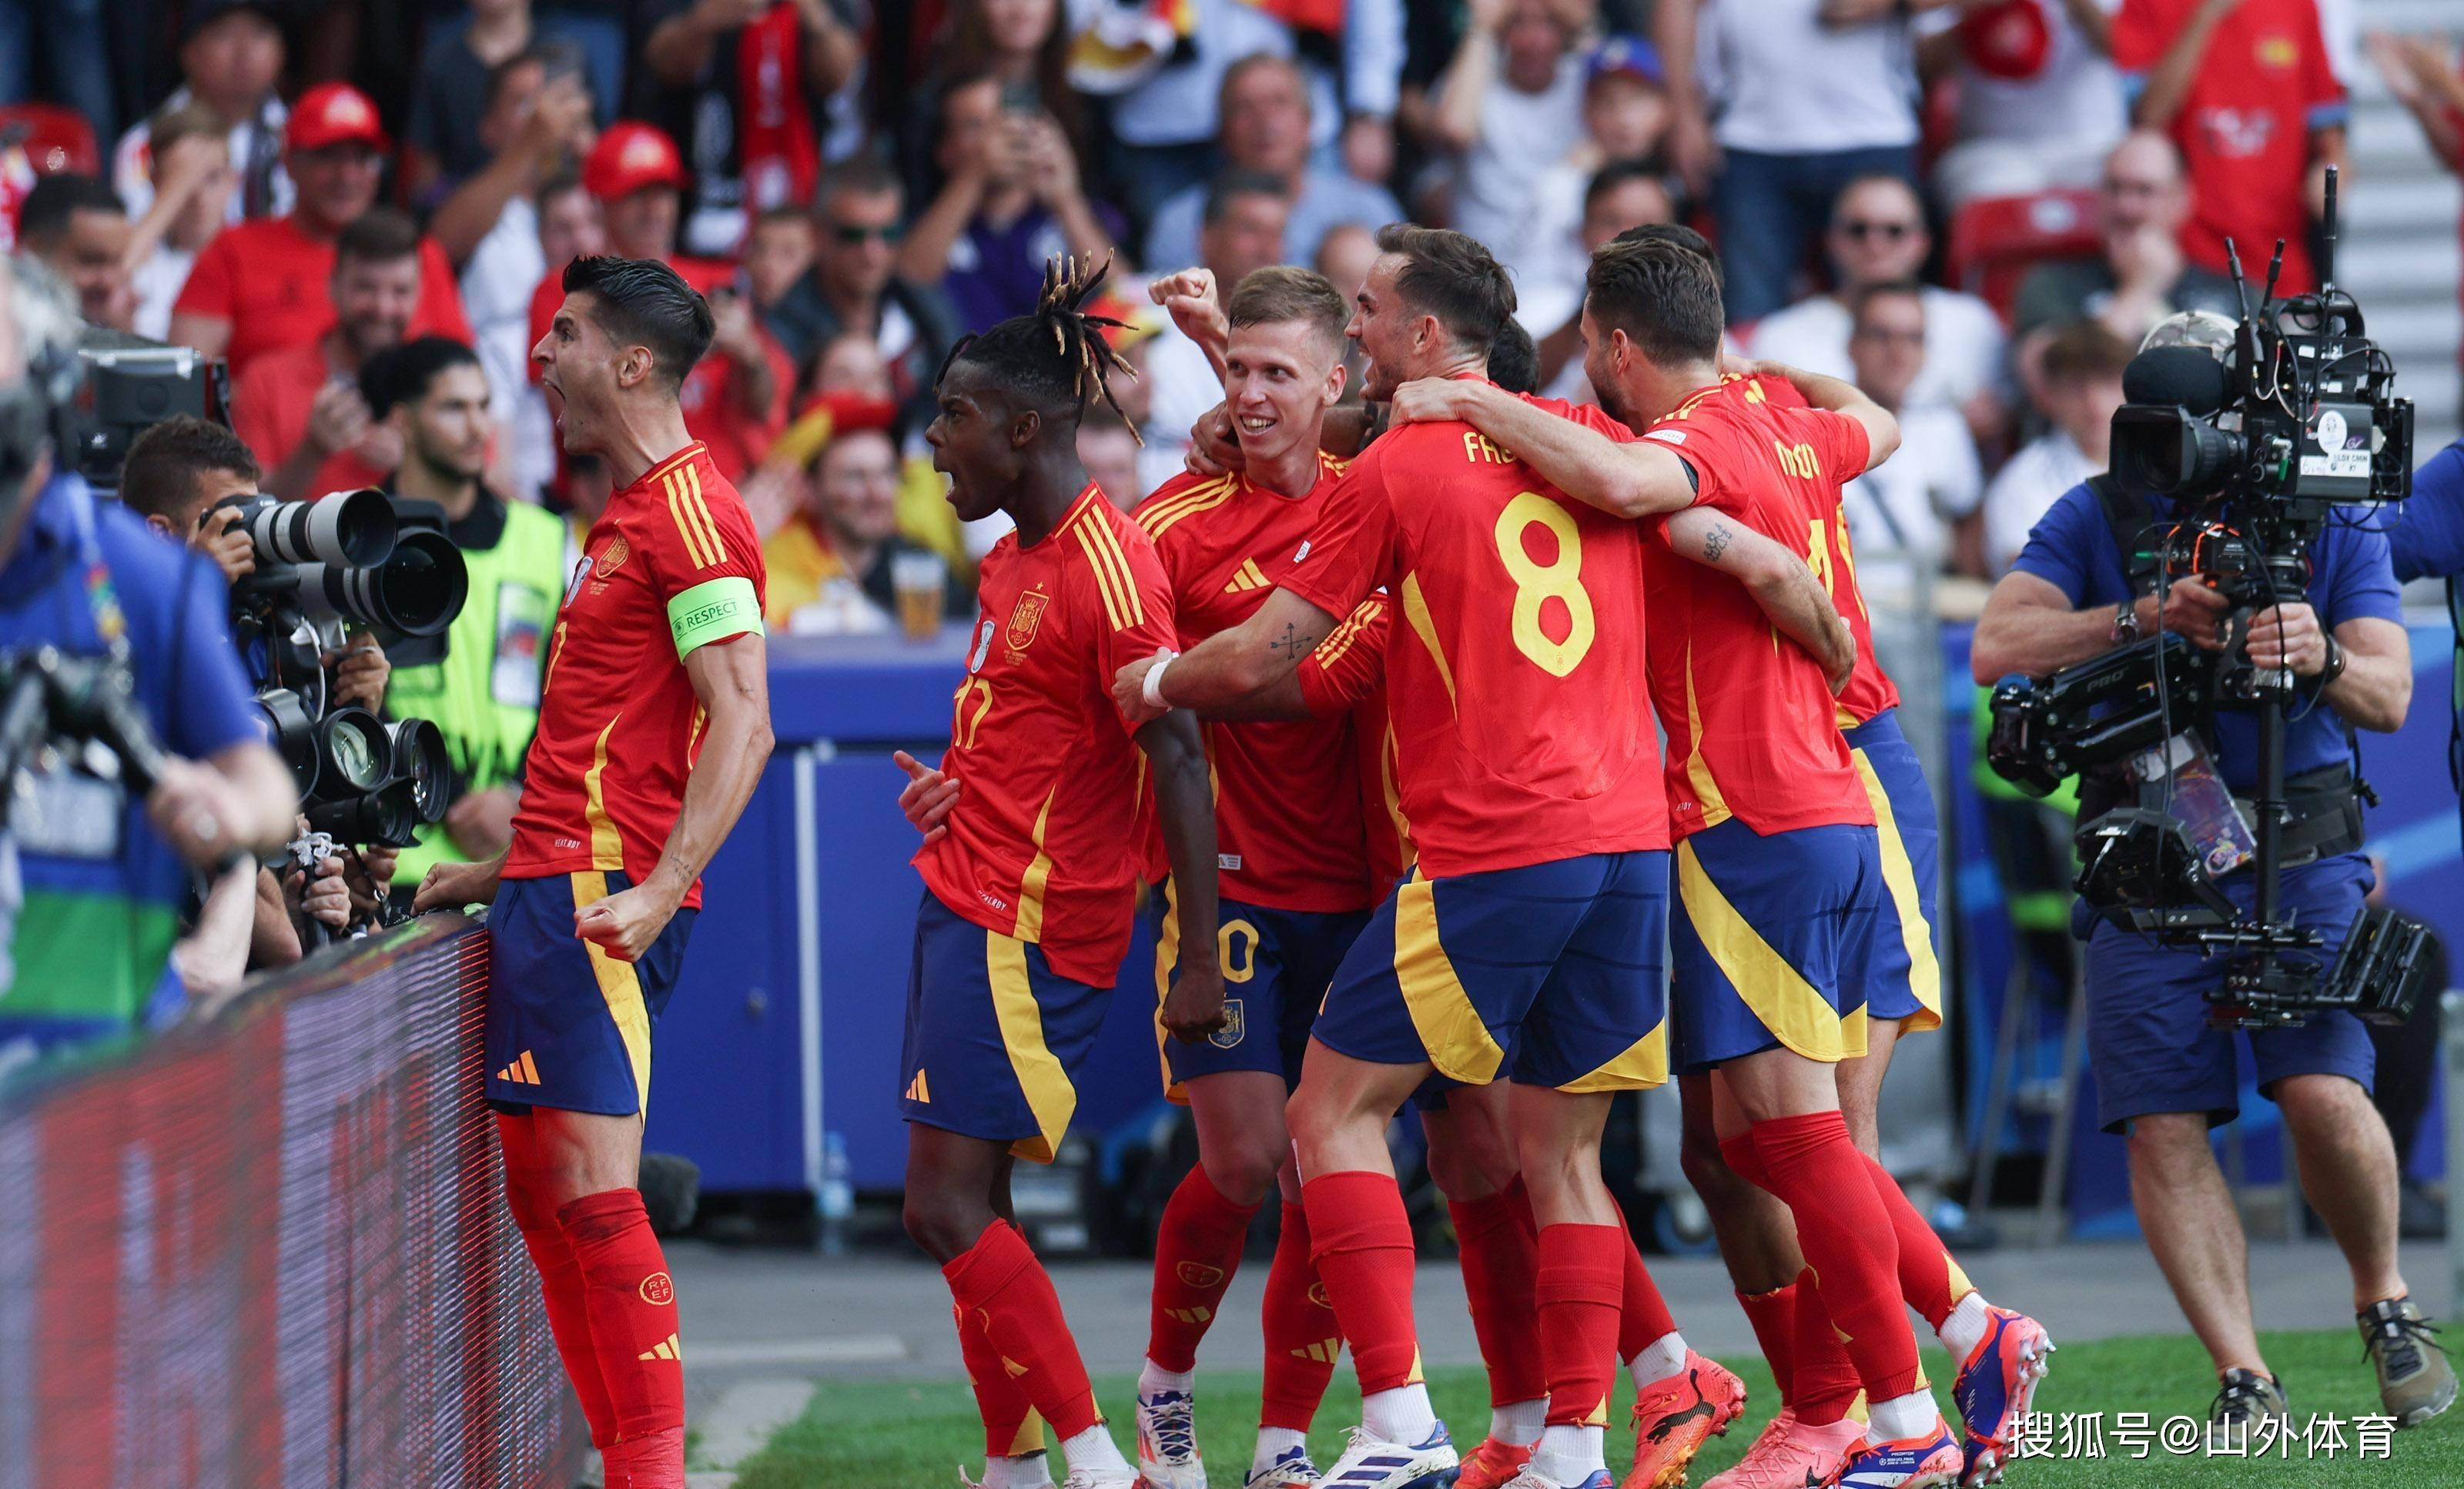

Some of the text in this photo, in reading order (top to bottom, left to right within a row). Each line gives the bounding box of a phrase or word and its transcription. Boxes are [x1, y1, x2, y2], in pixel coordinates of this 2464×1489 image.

[686, 601, 738, 628] RESPECT
[1494, 490, 1596, 678] 8
[953, 674, 993, 750] 17
